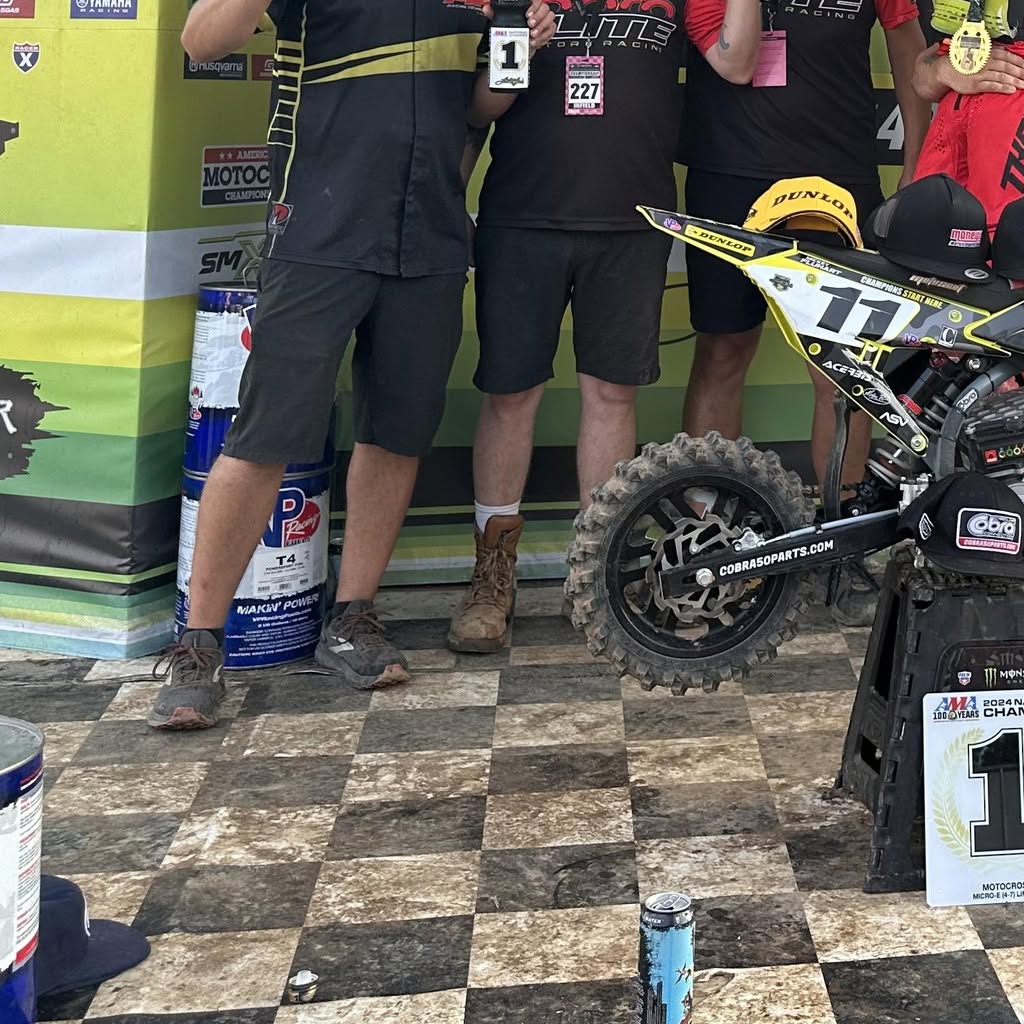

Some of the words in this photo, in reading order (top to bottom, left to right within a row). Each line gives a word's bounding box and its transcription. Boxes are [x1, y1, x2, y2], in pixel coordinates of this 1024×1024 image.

[784, 6, 856, 20] RACING
[18, 52, 33, 68] X
[501, 41, 519, 70] 1
[569, 82, 600, 100] 227
[237, 149, 269, 162] AMERIC
[203, 164, 269, 187] MOTOC
[771, 190, 854, 220] DUNLOP
[698, 230, 753, 253] DUNLOP
[860, 275, 903, 297] CHAMPIONS
[903, 289, 925, 305] START
[879, 411, 909, 427] ASV
[285, 513, 321, 539] Racing
[275, 553, 297, 566] T4
[718, 537, 835, 578] COBRA50PARTS.COM
[236, 601, 283, 615] MAKIN'
[936, 696, 978, 713] AMA
[983, 698, 1013, 708] 2024
[932, 710, 948, 721] 100
[957, 710, 980, 720] YEARS
[972, 890, 1002, 901] MICRO-E
[1001, 890, 1016, 900] (4-7)
